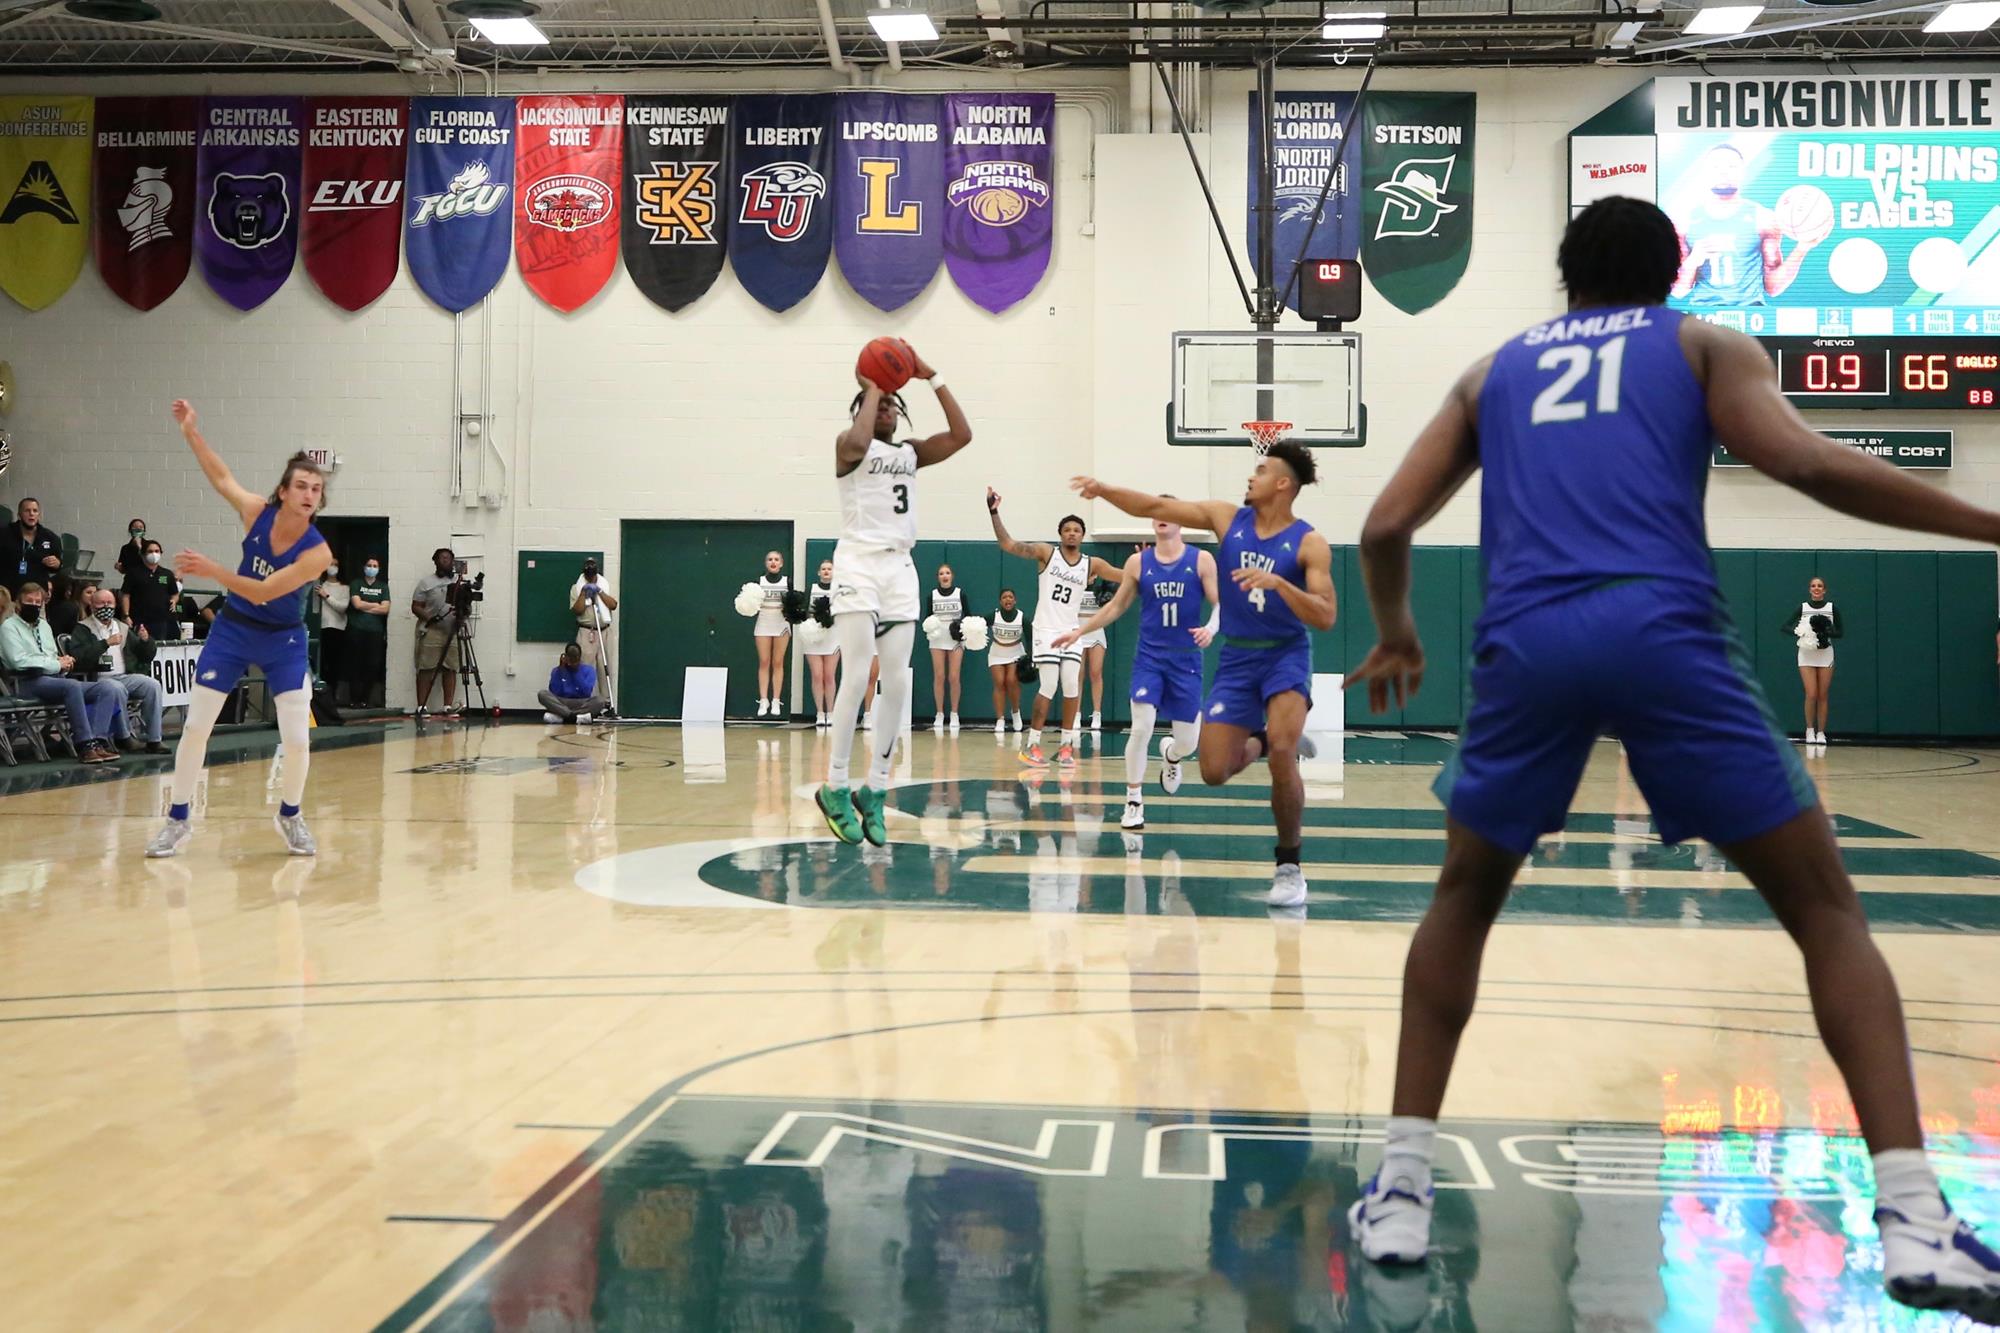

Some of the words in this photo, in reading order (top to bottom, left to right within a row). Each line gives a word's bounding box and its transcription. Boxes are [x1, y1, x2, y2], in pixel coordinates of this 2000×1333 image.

[1274, 102, 1336, 119] NORTH
[1677, 78, 1992, 128] JACKSONVILLE
[23, 106, 62, 120] ASUN
[210, 108, 292, 126] CENTRAL
[316, 108, 398, 126] EASTERN
[430, 110, 496, 127] FLORIDA
[519, 107, 621, 126] JACKSONVILLE
[627, 107, 727, 125] KENNESAW
[968, 106, 1031, 124] NORTH
[98, 130, 196, 148] BELLARMINE
[201, 128, 300, 146] ARKANSAS
[309, 128, 404, 147] KENTUCKY
[415, 128, 454, 145] GULF
[459, 129, 510, 145] COAST
[549, 128, 590, 146] STATE
[649, 127, 705, 146] STATE
[745, 127, 823, 146] LIBERTY
[843, 121, 938, 142] LIPSCOMB
[953, 126, 1046, 145] ALABAMA
[1375, 125, 1462, 145] STETSON
[1277, 148, 1332, 167] NORTH
[1798, 141, 1999, 183] DOLPHINS
[966, 163, 1031, 180] NORTH
[1274, 164, 1345, 191] LORIDA
[1589, 163, 1647, 179] W.B.MASON
[312, 180, 402, 205] EKU
[586, 179, 608, 196] STATE
[951, 175, 1047, 196] ALABAMA
[1869, 171, 1929, 206] VS
[411, 184, 508, 227] FGCU
[857, 157, 922, 235] L
[532, 208, 602, 221] GAMECOCKS
[739, 176, 815, 242] LU
[1839, 200, 1954, 229] EAGLES
[1523, 307, 1653, 346] SAMUEL
[1828, 310, 1841, 324] 2
[1905, 313, 1917, 333] 1
[1928, 313, 1949, 321] TIME
[1963, 313, 1978, 333] 4
[1928, 323, 1951, 332] OUTS
[1955, 355, 1998, 369] EAGLES
[1531, 335, 1627, 426] 21
[1806, 354, 1861, 390] 0.9
[1904, 354, 1949, 390] 66
[1857, 446, 1893, 456] ANIE
[1898, 446, 1946, 457] COST
[892, 484, 909, 514] 3
[252, 555, 275, 577] FGC
[1240, 551, 1276, 574] FGCU
[1050, 565, 1084, 586] Dolphins
[1051, 583, 1072, 604] 23
[1153, 582, 1184, 598] FGCU
[1248, 588, 1266, 613] 4
[1161, 602, 1178, 627] 11
